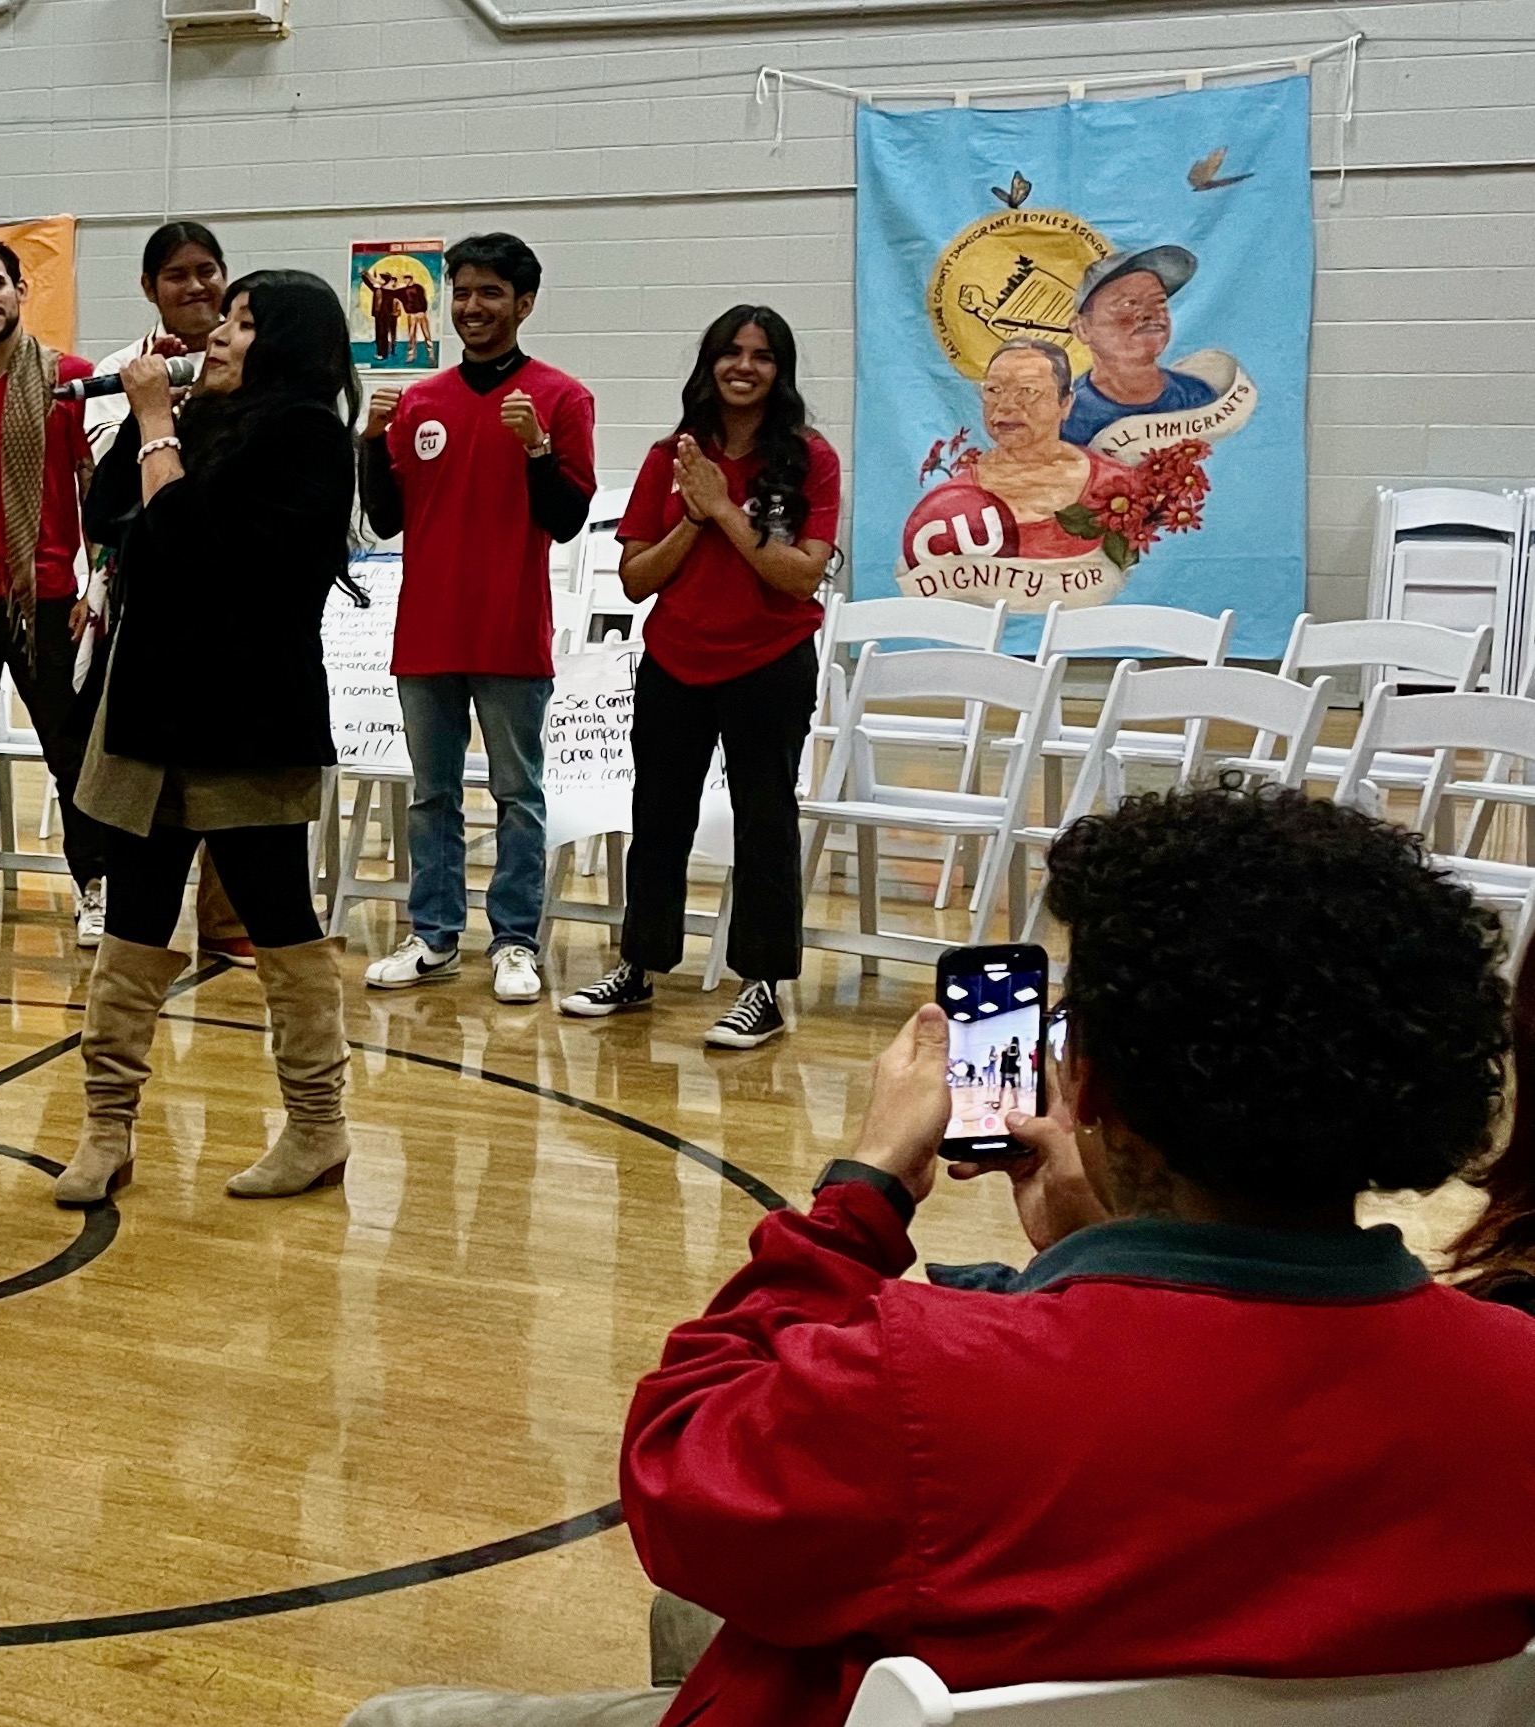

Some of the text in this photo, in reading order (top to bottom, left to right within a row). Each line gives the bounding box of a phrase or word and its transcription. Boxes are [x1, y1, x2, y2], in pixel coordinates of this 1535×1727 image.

[934, 260, 952, 304] COUNTY
[1015, 213, 1070, 229] PEOPLE'S
[1102, 384, 1250, 458] ALL IMMIGRANTS
[421, 439, 436, 451] CU
[913, 505, 1004, 566] CU
[915, 565, 1104, 597] DIGNITY FOR
[343, 685, 394, 697] nombre
[596, 694, 634, 710] Contr
[548, 729, 565, 743] un
[601, 747, 624, 764] que
